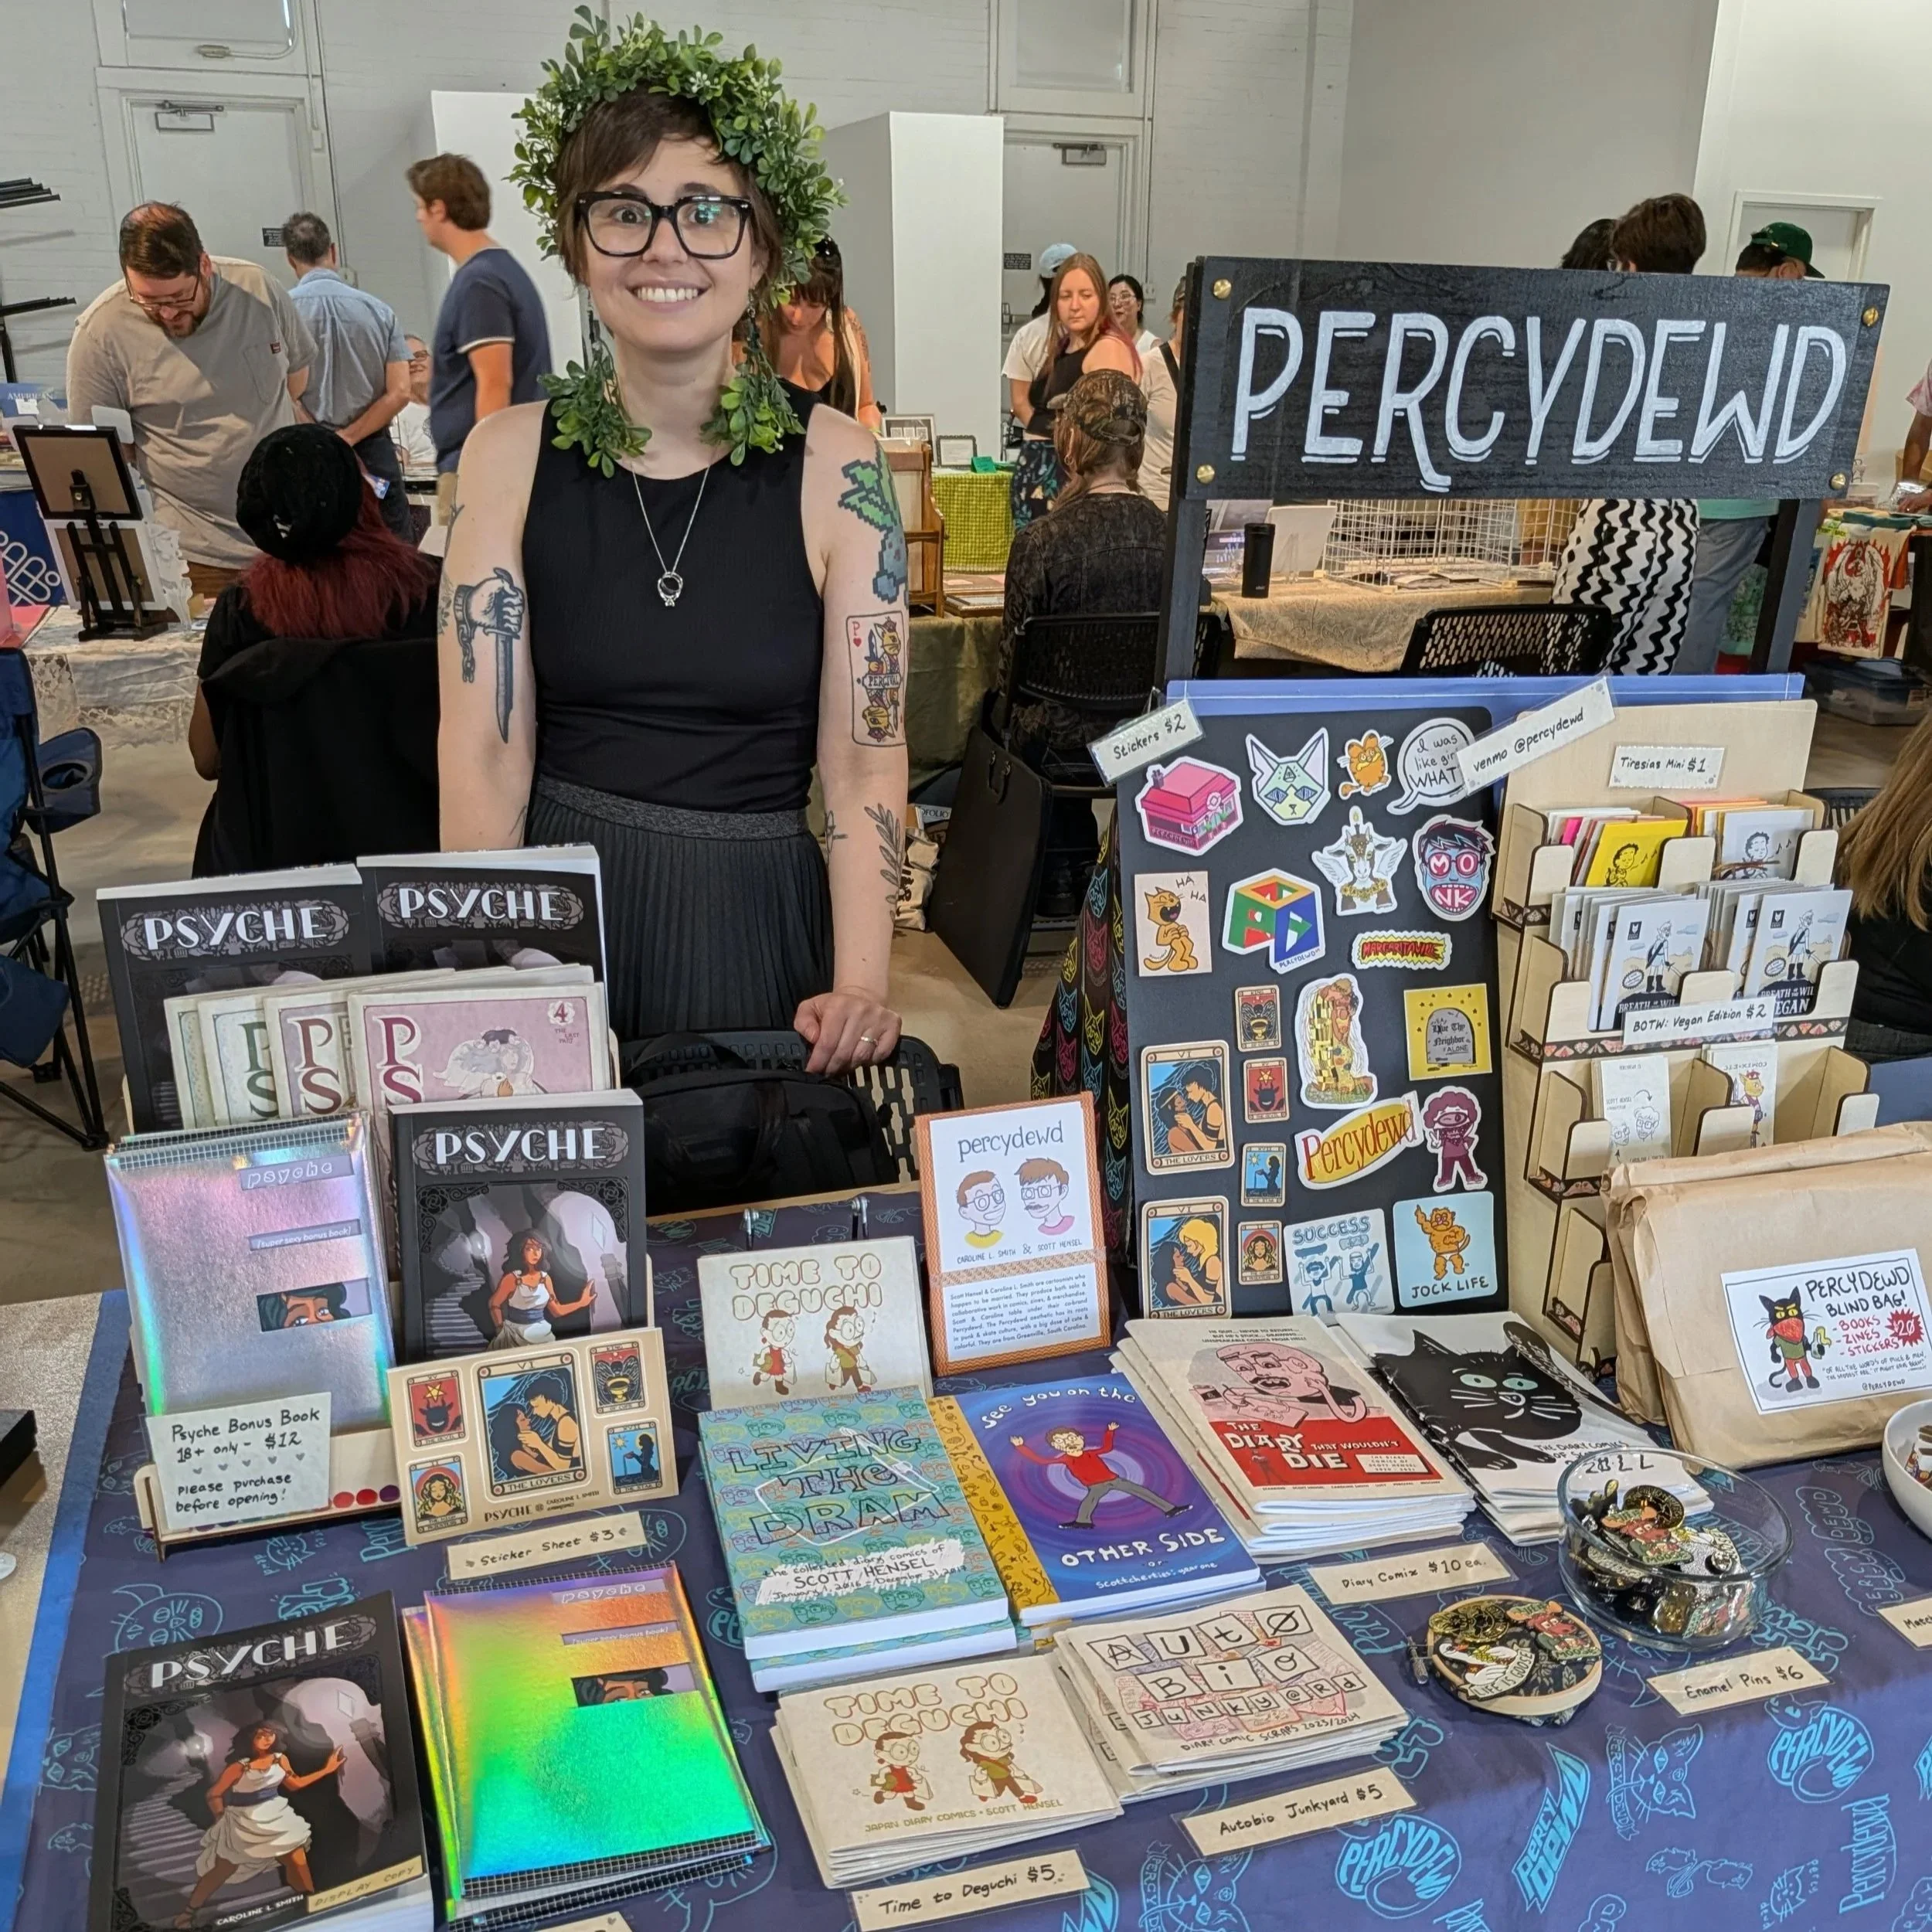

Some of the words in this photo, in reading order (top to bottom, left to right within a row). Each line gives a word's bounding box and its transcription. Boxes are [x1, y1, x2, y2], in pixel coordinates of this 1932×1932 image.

[1230, 307, 1845, 492] PERCYDEWD
[852, 621, 860, 636] P
[868, 675, 900, 687] PERCIVAL
[1114, 732, 1159, 760] Stickers
[1165, 713, 1186, 734] $2
[1417, 738, 1428, 754] I
[1434, 735, 1458, 749] was
[1473, 750, 1508, 773] venmo
[1514, 708, 1584, 753] @percydewd
[1414, 755, 1437, 771] like
[1621, 757, 1661, 770] Tiresias
[1666, 760, 1685, 770] Mini
[1688, 757, 1706, 773] $1
[1411, 767, 1458, 789] WHAT
[1175, 875, 1196, 888] HA
[400, 889, 563, 921] PSYCHE
[1190, 890, 1206, 903] HA
[144, 906, 327, 951] PSYCHE
[553, 1003, 568, 1023] 4
[1633, 1019, 1668, 1032] BOTW:
[1673, 1015, 1703, 1032] Vegan
[1707, 1009, 1741, 1022] Edition
[1746, 1004, 1767, 1019] $2
[1774, 998, 1810, 1015] EGAN
[1433, 1036, 1465, 1046] Neighbor
[435, 1128, 607, 1165] PSYCHE
[957, 1120, 1064, 1163] percydewd
[1301, 1099, 1417, 1181] Percydewd
[1164, 1157, 1182, 1165] THE
[1183, 1154, 1216, 1164] LOVERS
[247, 1162, 333, 1189] psyche
[284, 1235, 302, 1244] sexy
[303, 1232, 328, 1242] bonus
[328, 1226, 352, 1237] book)
[1292, 1216, 1372, 1245] SUCCESS
[957, 1253, 985, 1264] CAROLINE
[998, 1249, 1016, 1258] SMITH
[1023, 1244, 1032, 1254] &
[1038, 1243, 1056, 1252] SCOTT
[729, 1259, 821, 1291] TIME
[834, 1252, 882, 1281] TO
[990, 1285, 1012, 1294] Caroline
[1046, 1276, 1073, 1285] cartoonists
[1805, 1266, 1910, 1301] PERCYDEWD
[732, 1281, 883, 1321] DEGUCHI
[1031, 1287, 1052, 1296] produce
[1412, 1284, 1452, 1300] JOCK
[1456, 1276, 1489, 1291] LIFE
[981, 1312, 1004, 1321] Caroline
[1162, 1309, 1179, 1318] THE
[1180, 1307, 1213, 1317] LOVERS
[1825, 1298, 1869, 1318] BLIND
[1872, 1289, 1908, 1310] BAG!
[998, 1316, 1028, 1326] Percydewd
[1838, 1315, 1880, 1332] BOOKS
[1842, 1328, 1880, 1345] ZINES
[1848, 1338, 1900, 1356] STICKERS
[517, 1361, 534, 1370] VI
[1862, 1379, 1906, 1391] @PERCYDEWD
[981, 1404, 1012, 1429] See
[1022, 1390, 1062, 1406] you
[1067, 1388, 1090, 1396] on
[1098, 1387, 1136, 1403] the
[172, 1423, 220, 1444] Psyche
[228, 1416, 274, 1432] Bonus
[281, 1407, 321, 1427] Book
[1226, 1422, 1262, 1432] THE
[176, 1447, 205, 1463] 18+
[213, 1440, 239, 1455] only
[264, 1431, 302, 1450] $12
[728, 1430, 922, 1474] LIVING
[1223, 1432, 1304, 1453] DIARY
[1311, 1443, 1338, 1451] THAT
[1340, 1440, 1400, 1451] WOULDN'T
[1556, 1442, 1589, 1451] DIARY
[1281, 1452, 1349, 1469] DIE
[233, 1474, 292, 1490] purchase
[508, 1481, 528, 1492] THE
[530, 1475, 571, 1488] LOVERS
[175, 1496, 219, 1514] before
[228, 1488, 287, 1508] opening!
[485, 1505, 533, 1522] PSYCHE
[749, 1491, 951, 1546] DRAM
[480, 1549, 532, 1566] Sticker
[542, 1537, 582, 1552] Sheet
[590, 1529, 614, 1543] $3
[762, 1566, 788, 1577] the
[794, 1559, 845, 1574] collected
[853, 1553, 885, 1566] diary
[889, 1548, 927, 1561] comics
[933, 1544, 945, 1554] of
[1060, 1540, 1154, 1568] OTHER
[1166, 1528, 1226, 1553] SIDE
[794, 1570, 853, 1589] SCOTT
[865, 1557, 935, 1577] HENSEL
[1178, 1566, 1198, 1575] year
[1342, 1576, 1374, 1590] Diary
[1378, 1568, 1418, 1583] Comix
[1428, 1559, 1461, 1574] $10
[1465, 1559, 1487, 1570] ea.
[773, 1588, 822, 1601] January
[876, 1571, 923, 1584] December
[151, 1621, 353, 1689] PSYCHE
[1477, 1683, 1500, 1698] LIFE
[1505, 1675, 1515, 1686] IS
[1510, 1651, 1534, 1679] GOOSE
[1685, 1681, 1733, 1700] Enamel
[1740, 1672, 1771, 1687] Pins
[1777, 1665, 1804, 1682] $6
[823, 1683, 942, 1719] TIME
[955, 1672, 1019, 1699] TO
[832, 1697, 1029, 1747] DEGUCHI
[1181, 1738, 1216, 1751] DIARY
[1219, 1733, 1255, 1746] COMIC
[1259, 1725, 1300, 1742] SCRAPS
[1771, 1713, 1870, 1789] PERCYDEWD
[865, 1820, 900, 1832] JAPAN
[903, 1815, 934, 1827] DIARY
[937, 1809, 977, 1822] COMICS
[986, 1804, 1017, 1816] SCOTT
[1022, 1798, 1064, 1811] HENSEL
[1219, 1813, 1275, 1836] Autobio
[1284, 1794, 1350, 1819] Junkyard
[1356, 1783, 1383, 1801] $5
[1339, 1818, 1458, 1900] PERCYDEWD
[315, 1881, 372, 1907] DISPLAY
[383, 1866, 414, 1883] COPY
[879, 1896, 923, 1916] Time
[934, 1889, 952, 1904] to
[962, 1873, 1019, 1899] Deguchi
[1026, 1863, 1056, 1884] $5
[216, 1906, 263, 1926] CAROLINE
[275, 1894, 304, 1908] SMITH
